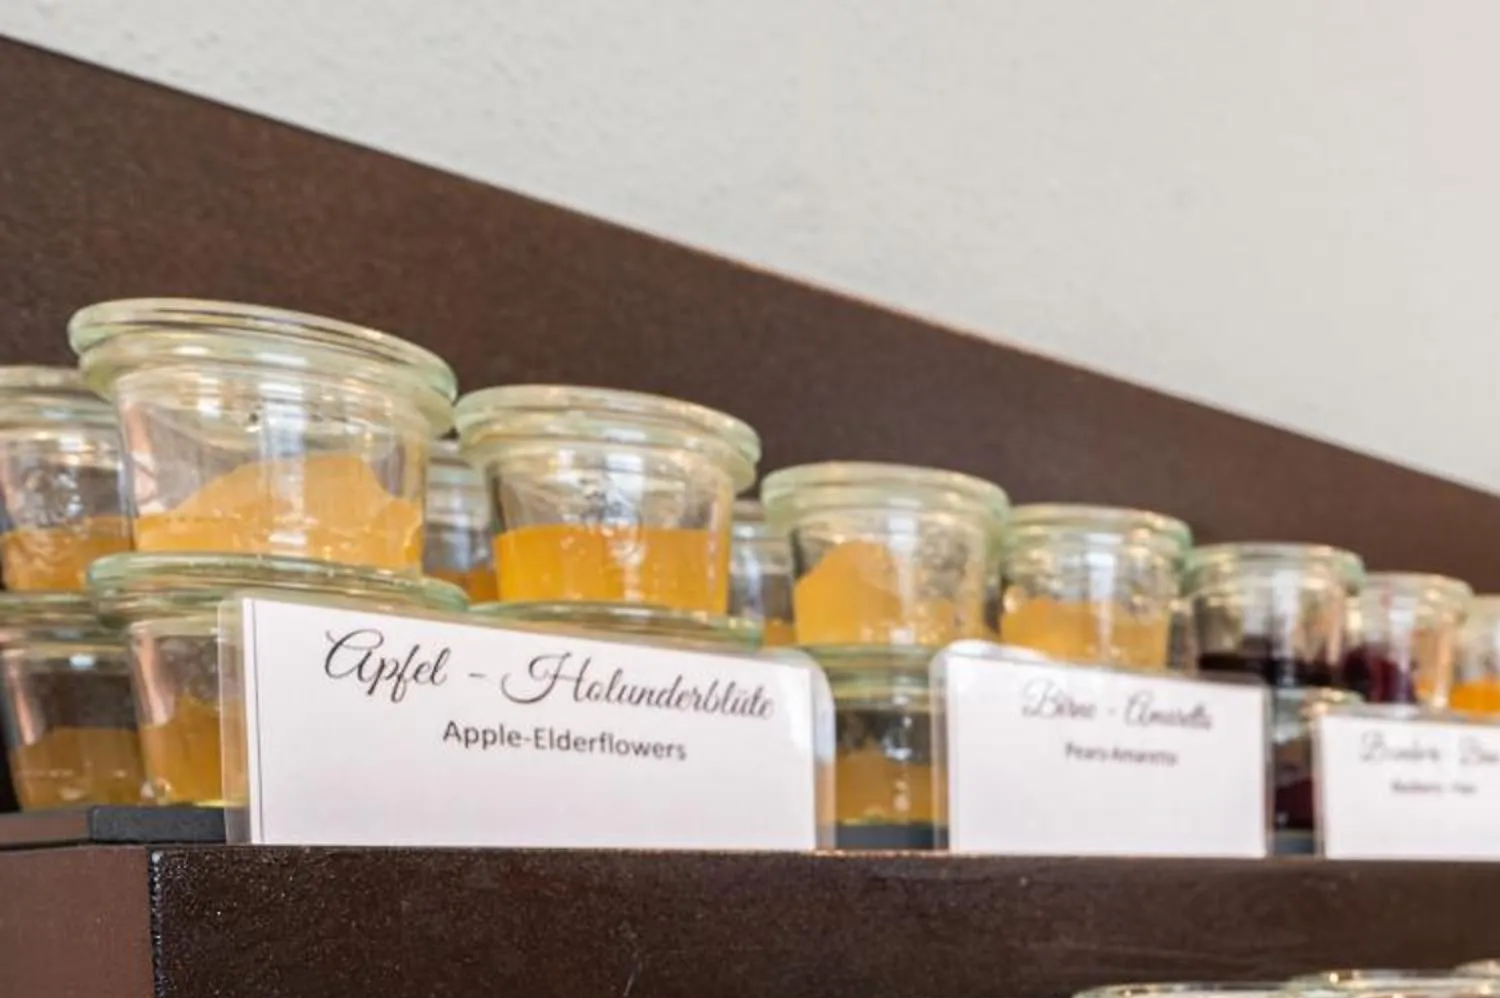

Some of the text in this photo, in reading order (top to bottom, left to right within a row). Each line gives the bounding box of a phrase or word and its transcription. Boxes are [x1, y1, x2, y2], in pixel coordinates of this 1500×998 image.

[323, 628, 452, 704] Apfel
[501, 651, 775, 721] Holunderblüte
[442, 719, 688, 761] Apple-Elderflowers
